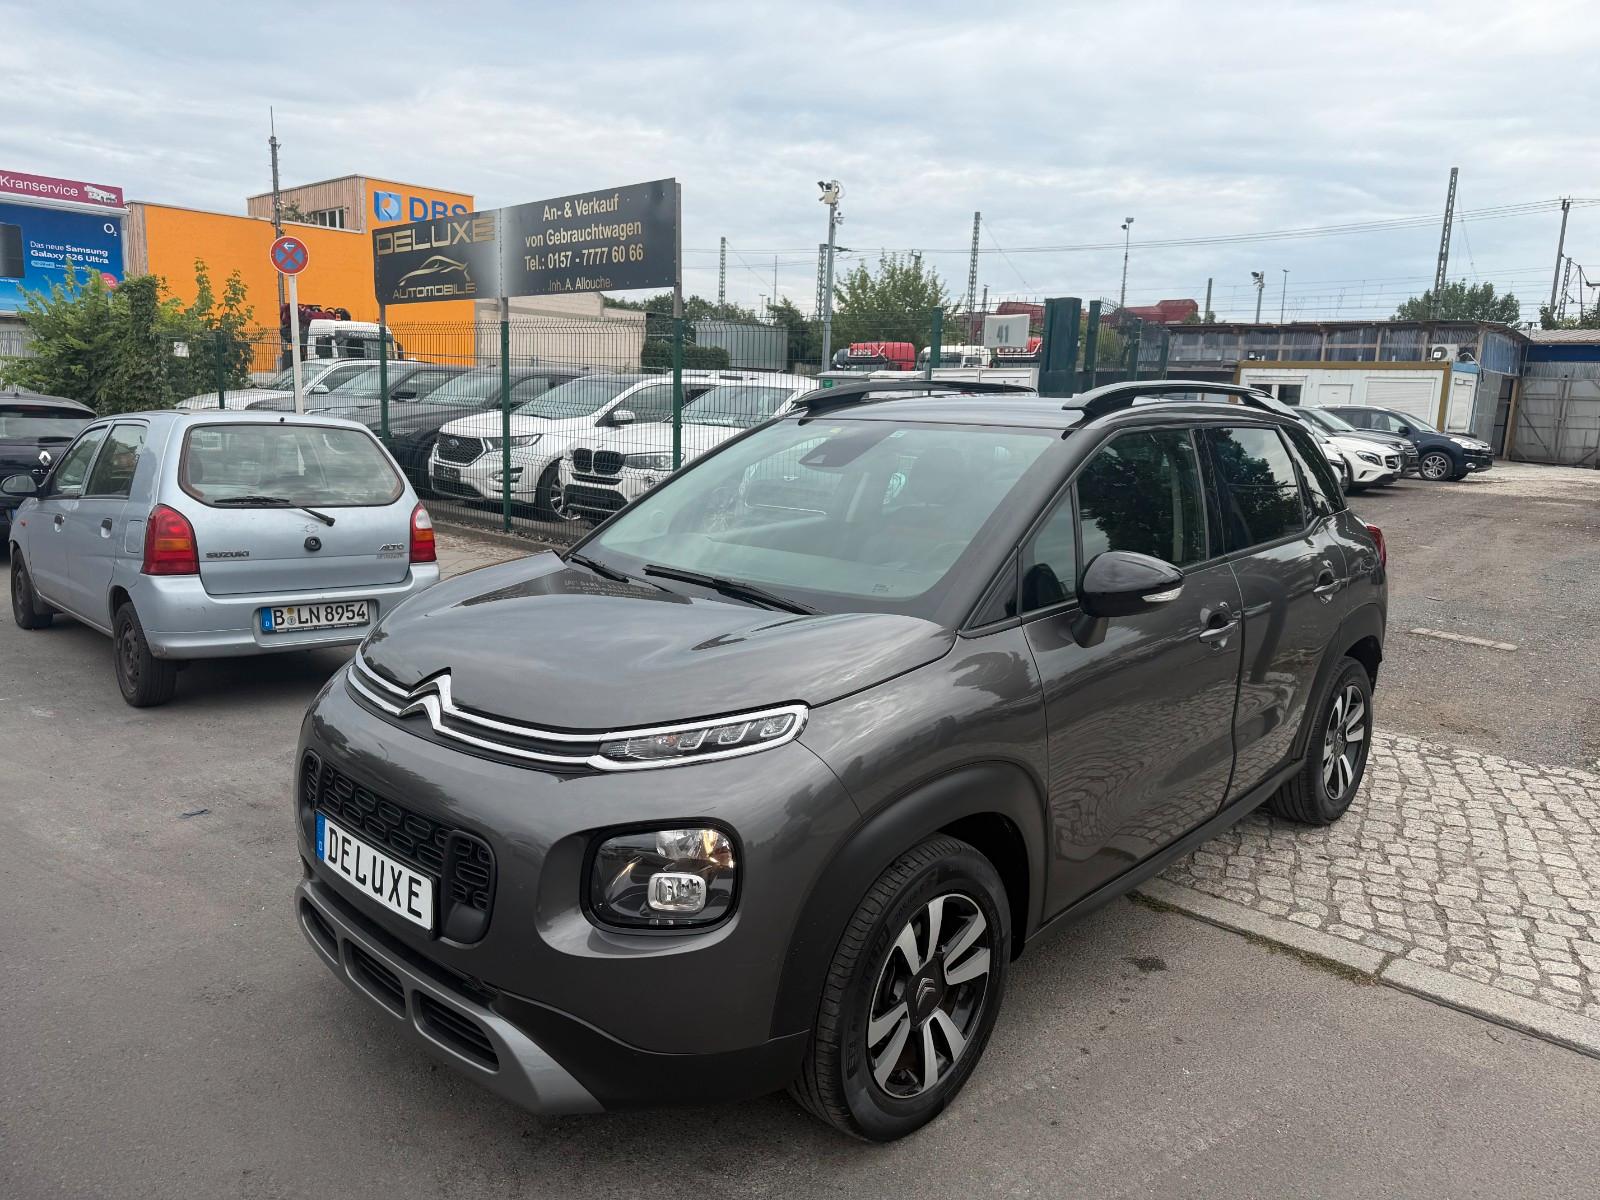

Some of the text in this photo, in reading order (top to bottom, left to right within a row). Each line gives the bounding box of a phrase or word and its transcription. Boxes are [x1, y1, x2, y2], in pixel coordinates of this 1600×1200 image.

[0, 175, 79, 197] Kranservice
[542, 193, 619, 222] An- & Verkauf
[376, 215, 496, 256] DELUXE
[525, 220, 642, 248] von Gebrauchtwagen
[30, 240, 108, 257] Das neue Samsung
[30, 249, 110, 264] Galaxy S26 Ultra
[524, 254, 545, 273] Tel.:
[547, 250, 572, 270] 0157
[582, 247, 609, 267] 7777
[611, 244, 626, 263] 60
[629, 243, 644, 262] 66
[392, 282, 476, 299] AUTOMOBILE
[575, 275, 611, 290] Allouche
[996, 324, 1009, 343] 41
[205, 550, 250, 559] SUZUKI
[378, 543, 405, 551] ALTO
[273, 603, 366, 626] B LN 8954
[327, 826, 423, 920] DELUXE
